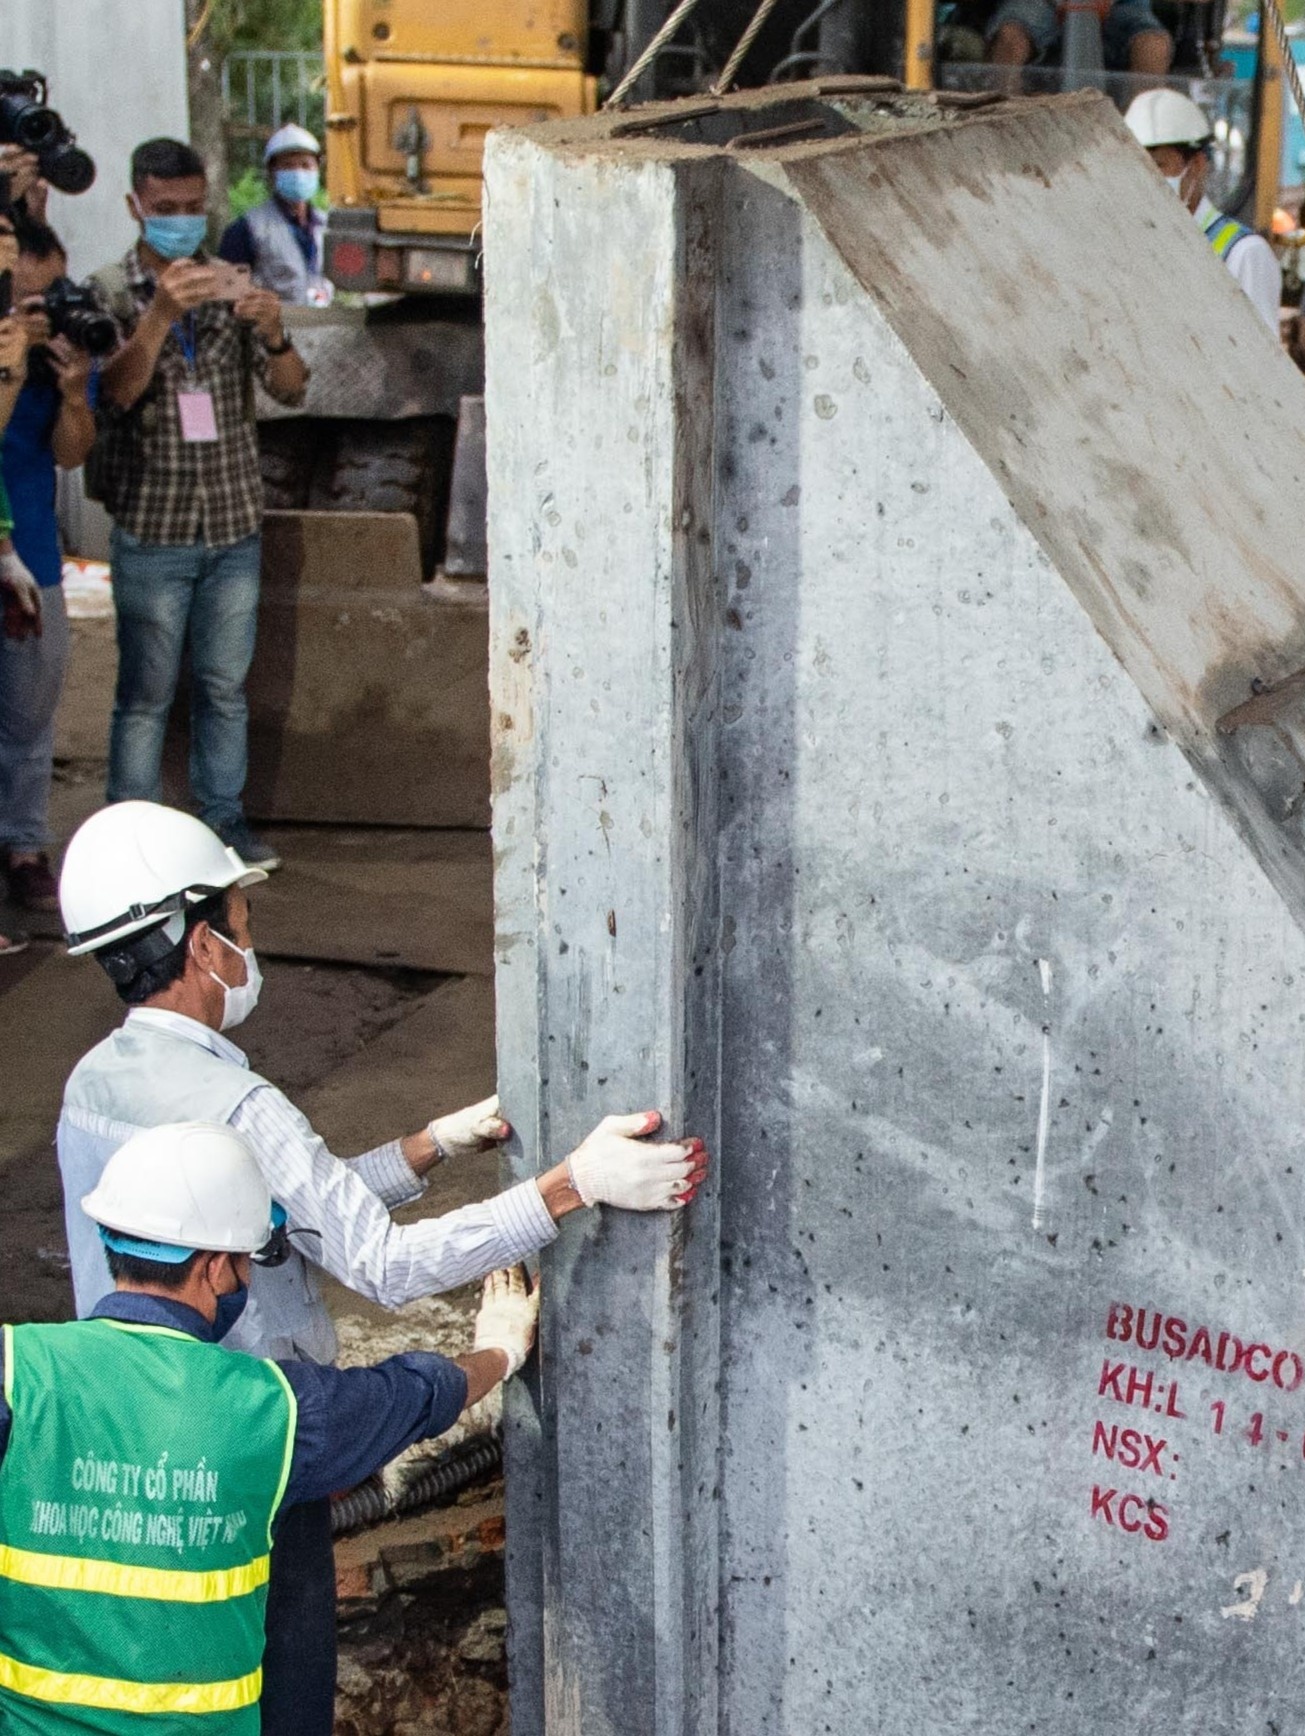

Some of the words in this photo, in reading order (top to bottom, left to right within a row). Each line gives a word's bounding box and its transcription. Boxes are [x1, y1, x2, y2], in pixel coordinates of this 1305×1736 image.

[1107, 1302, 1304, 1391] BUSADCO
[72, 1451, 117, 1494] CÔNG
[121, 1463, 142, 1497] TY
[145, 1451, 168, 1501] CỔ
[1092, 1420, 1180, 1481] NSX:
[69, 1504, 99, 1544] HỌC
[101, 1501, 143, 1544] CÔNG
[145, 1507, 184, 1554] NGHỆ
[188, 1507, 223, 1550] VIỆT
[1091, 1485, 1169, 1541] KCS
